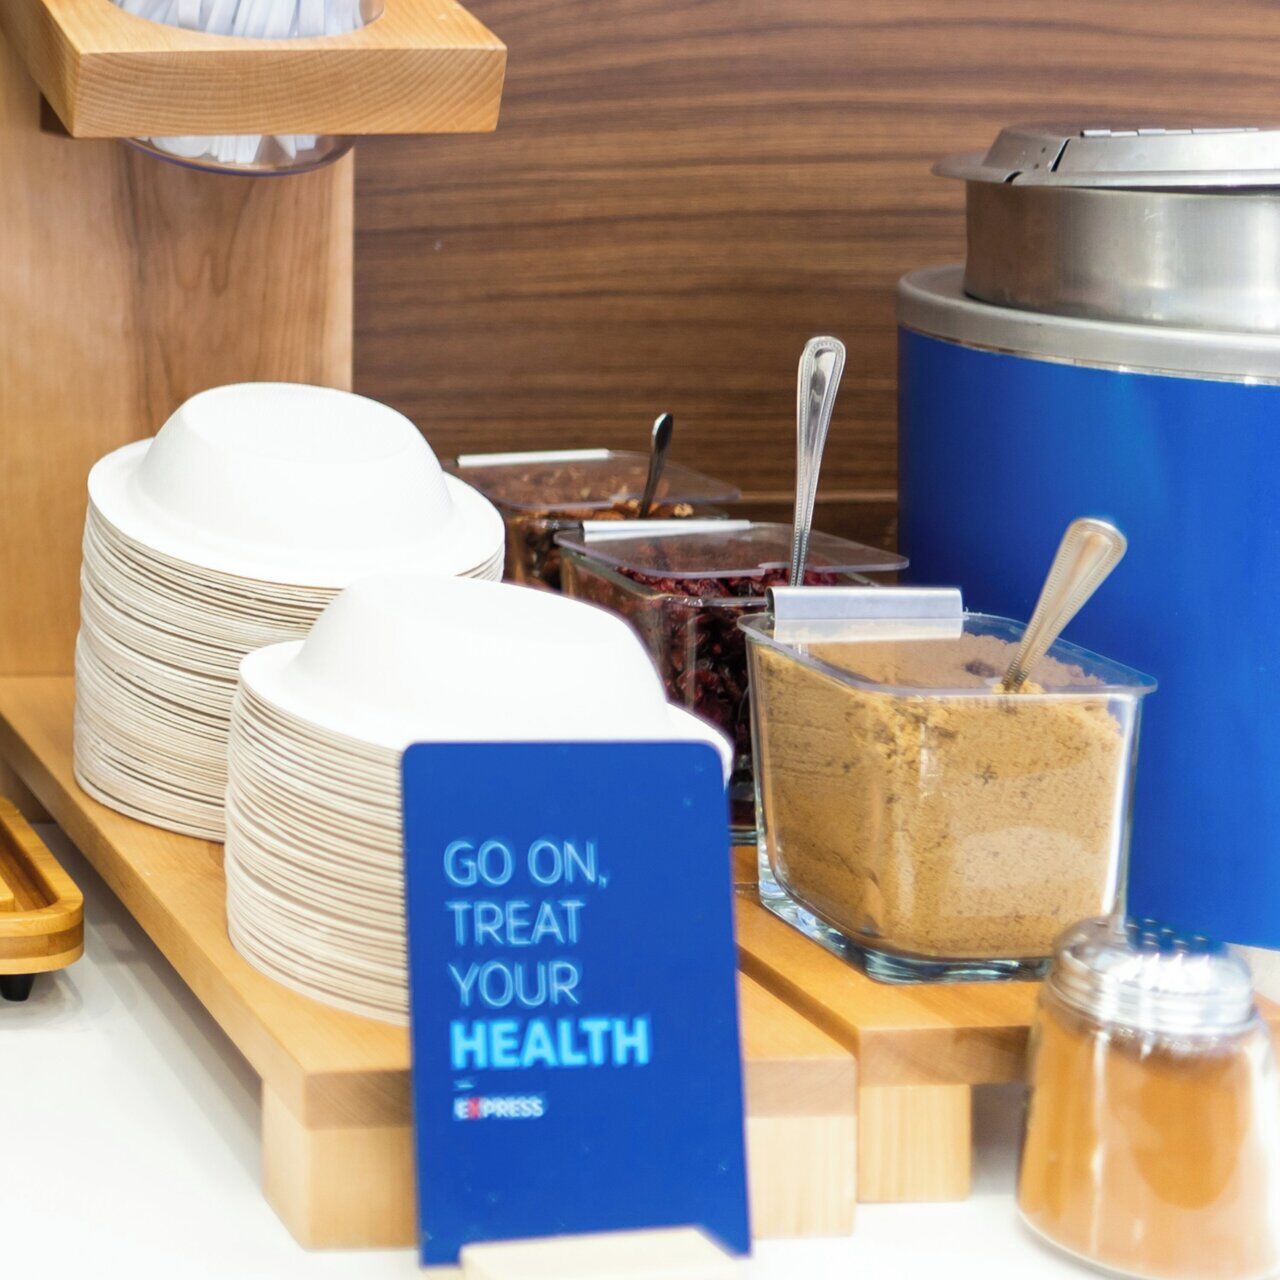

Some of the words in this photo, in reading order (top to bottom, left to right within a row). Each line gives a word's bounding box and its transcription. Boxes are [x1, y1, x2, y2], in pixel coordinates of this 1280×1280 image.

[443, 839, 513, 887] GO
[527, 839, 608, 889] ON,
[446, 900, 585, 947] TREAT
[450, 960, 580, 1009] YOUR
[450, 1017, 650, 1070] HEALTH
[453, 1096, 544, 1120] EXPRESS
